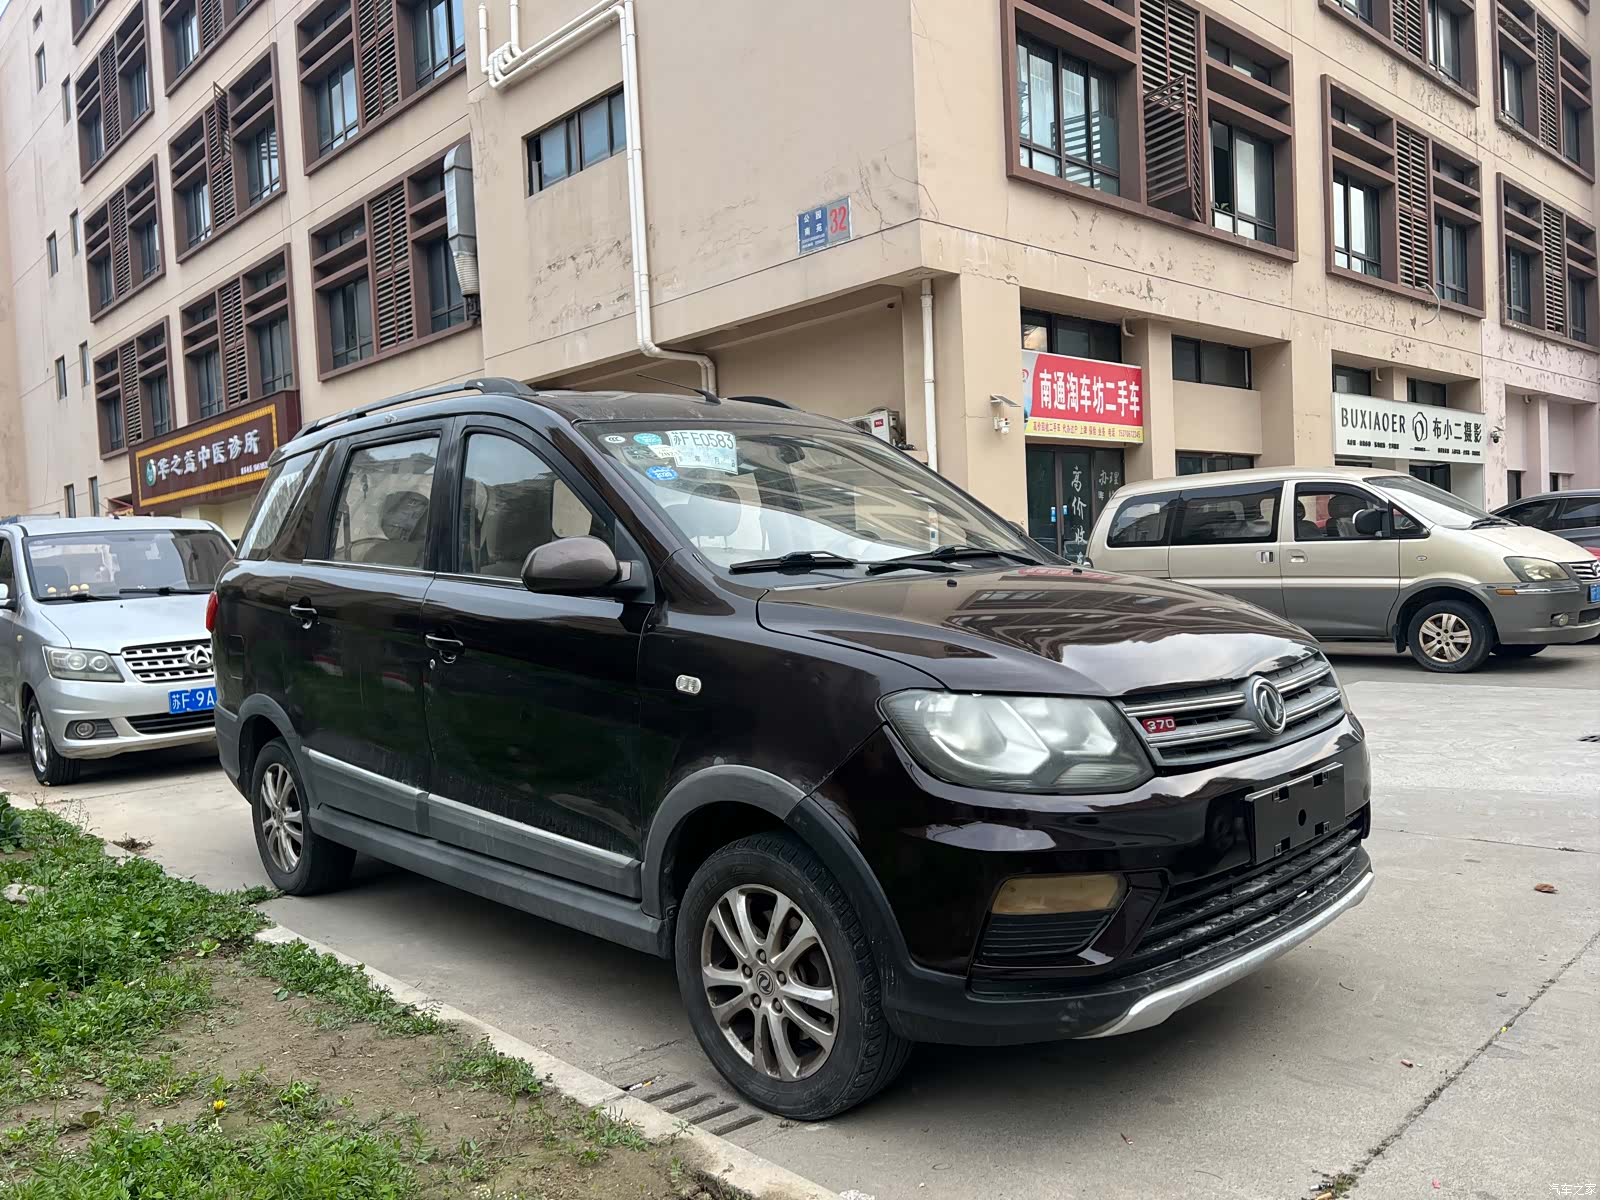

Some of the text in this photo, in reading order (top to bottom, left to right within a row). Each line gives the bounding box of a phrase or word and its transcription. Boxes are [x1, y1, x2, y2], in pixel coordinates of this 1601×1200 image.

[830, 205, 847, 234] 32
[1039, 368, 1141, 418] 南通淘车坊二手车
[1341, 407, 1406, 434] BUXIAOER
[1432, 417, 1482, 444] 布小二摄影
[1146, 718, 1175, 732] 370
